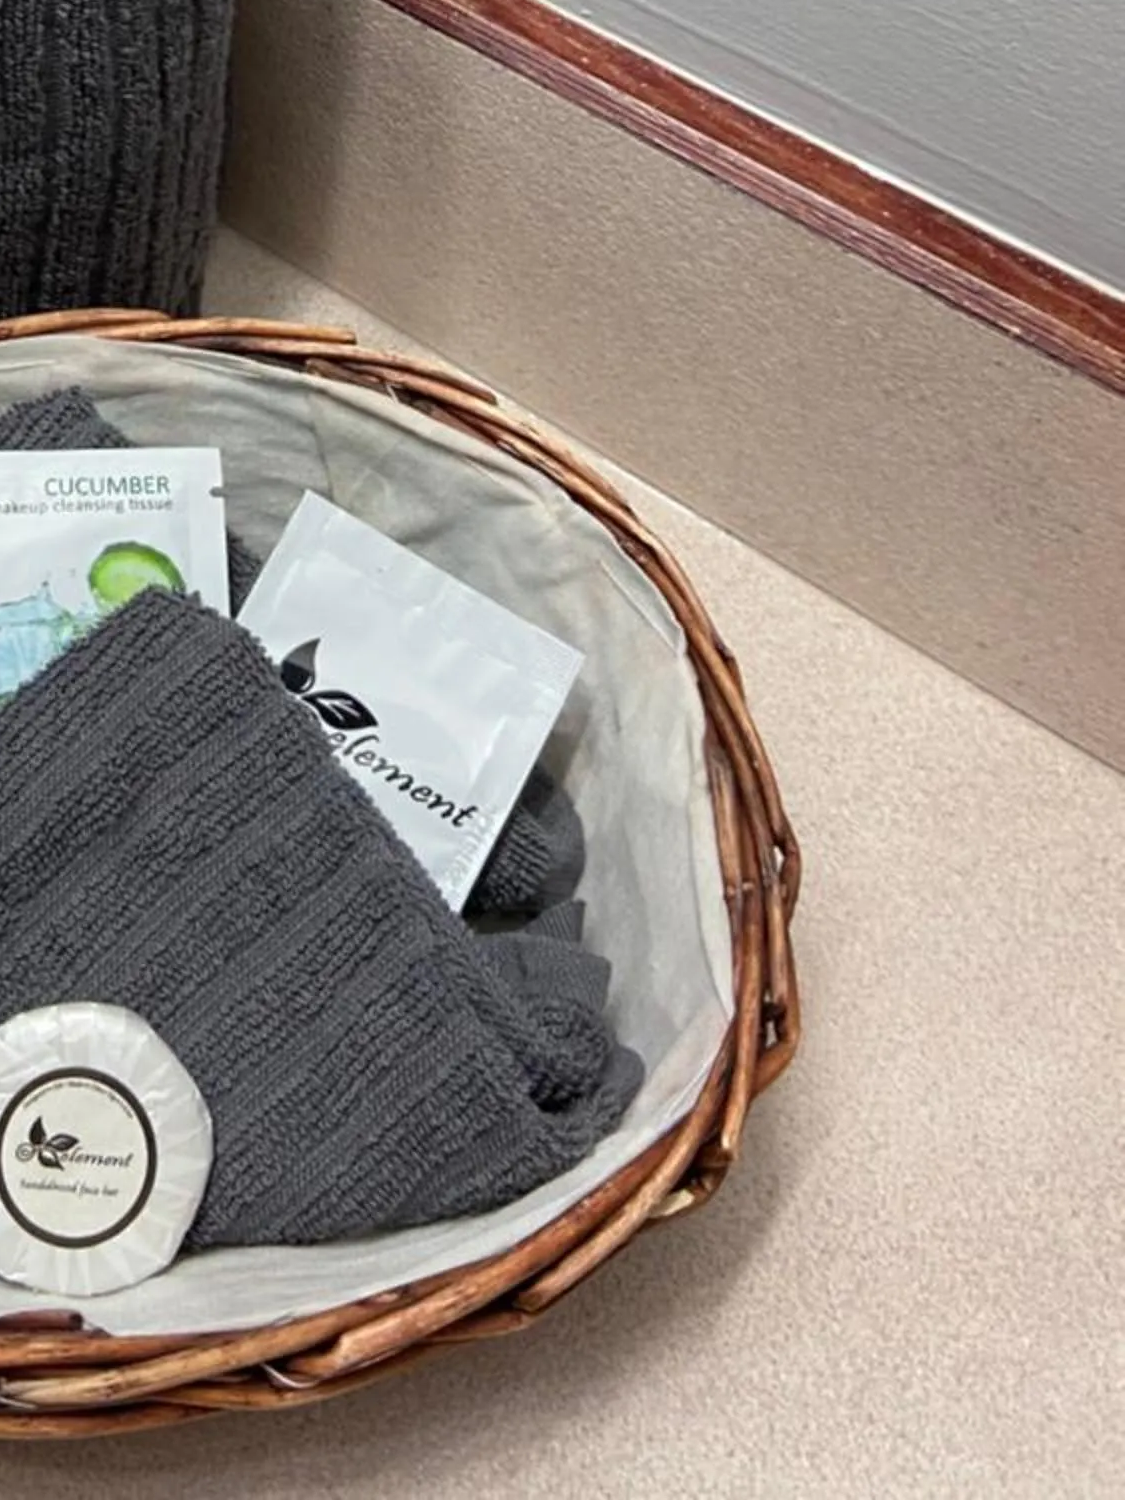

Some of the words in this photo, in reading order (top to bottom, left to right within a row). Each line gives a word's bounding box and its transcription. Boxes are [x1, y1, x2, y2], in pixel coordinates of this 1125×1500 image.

[44, 475, 171, 497] CUCUMBER
[52, 498, 125, 514] cleansing
[129, 497, 174, 512] tissue
[328, 734, 478, 828] element
[59, 1146, 134, 1167] element
